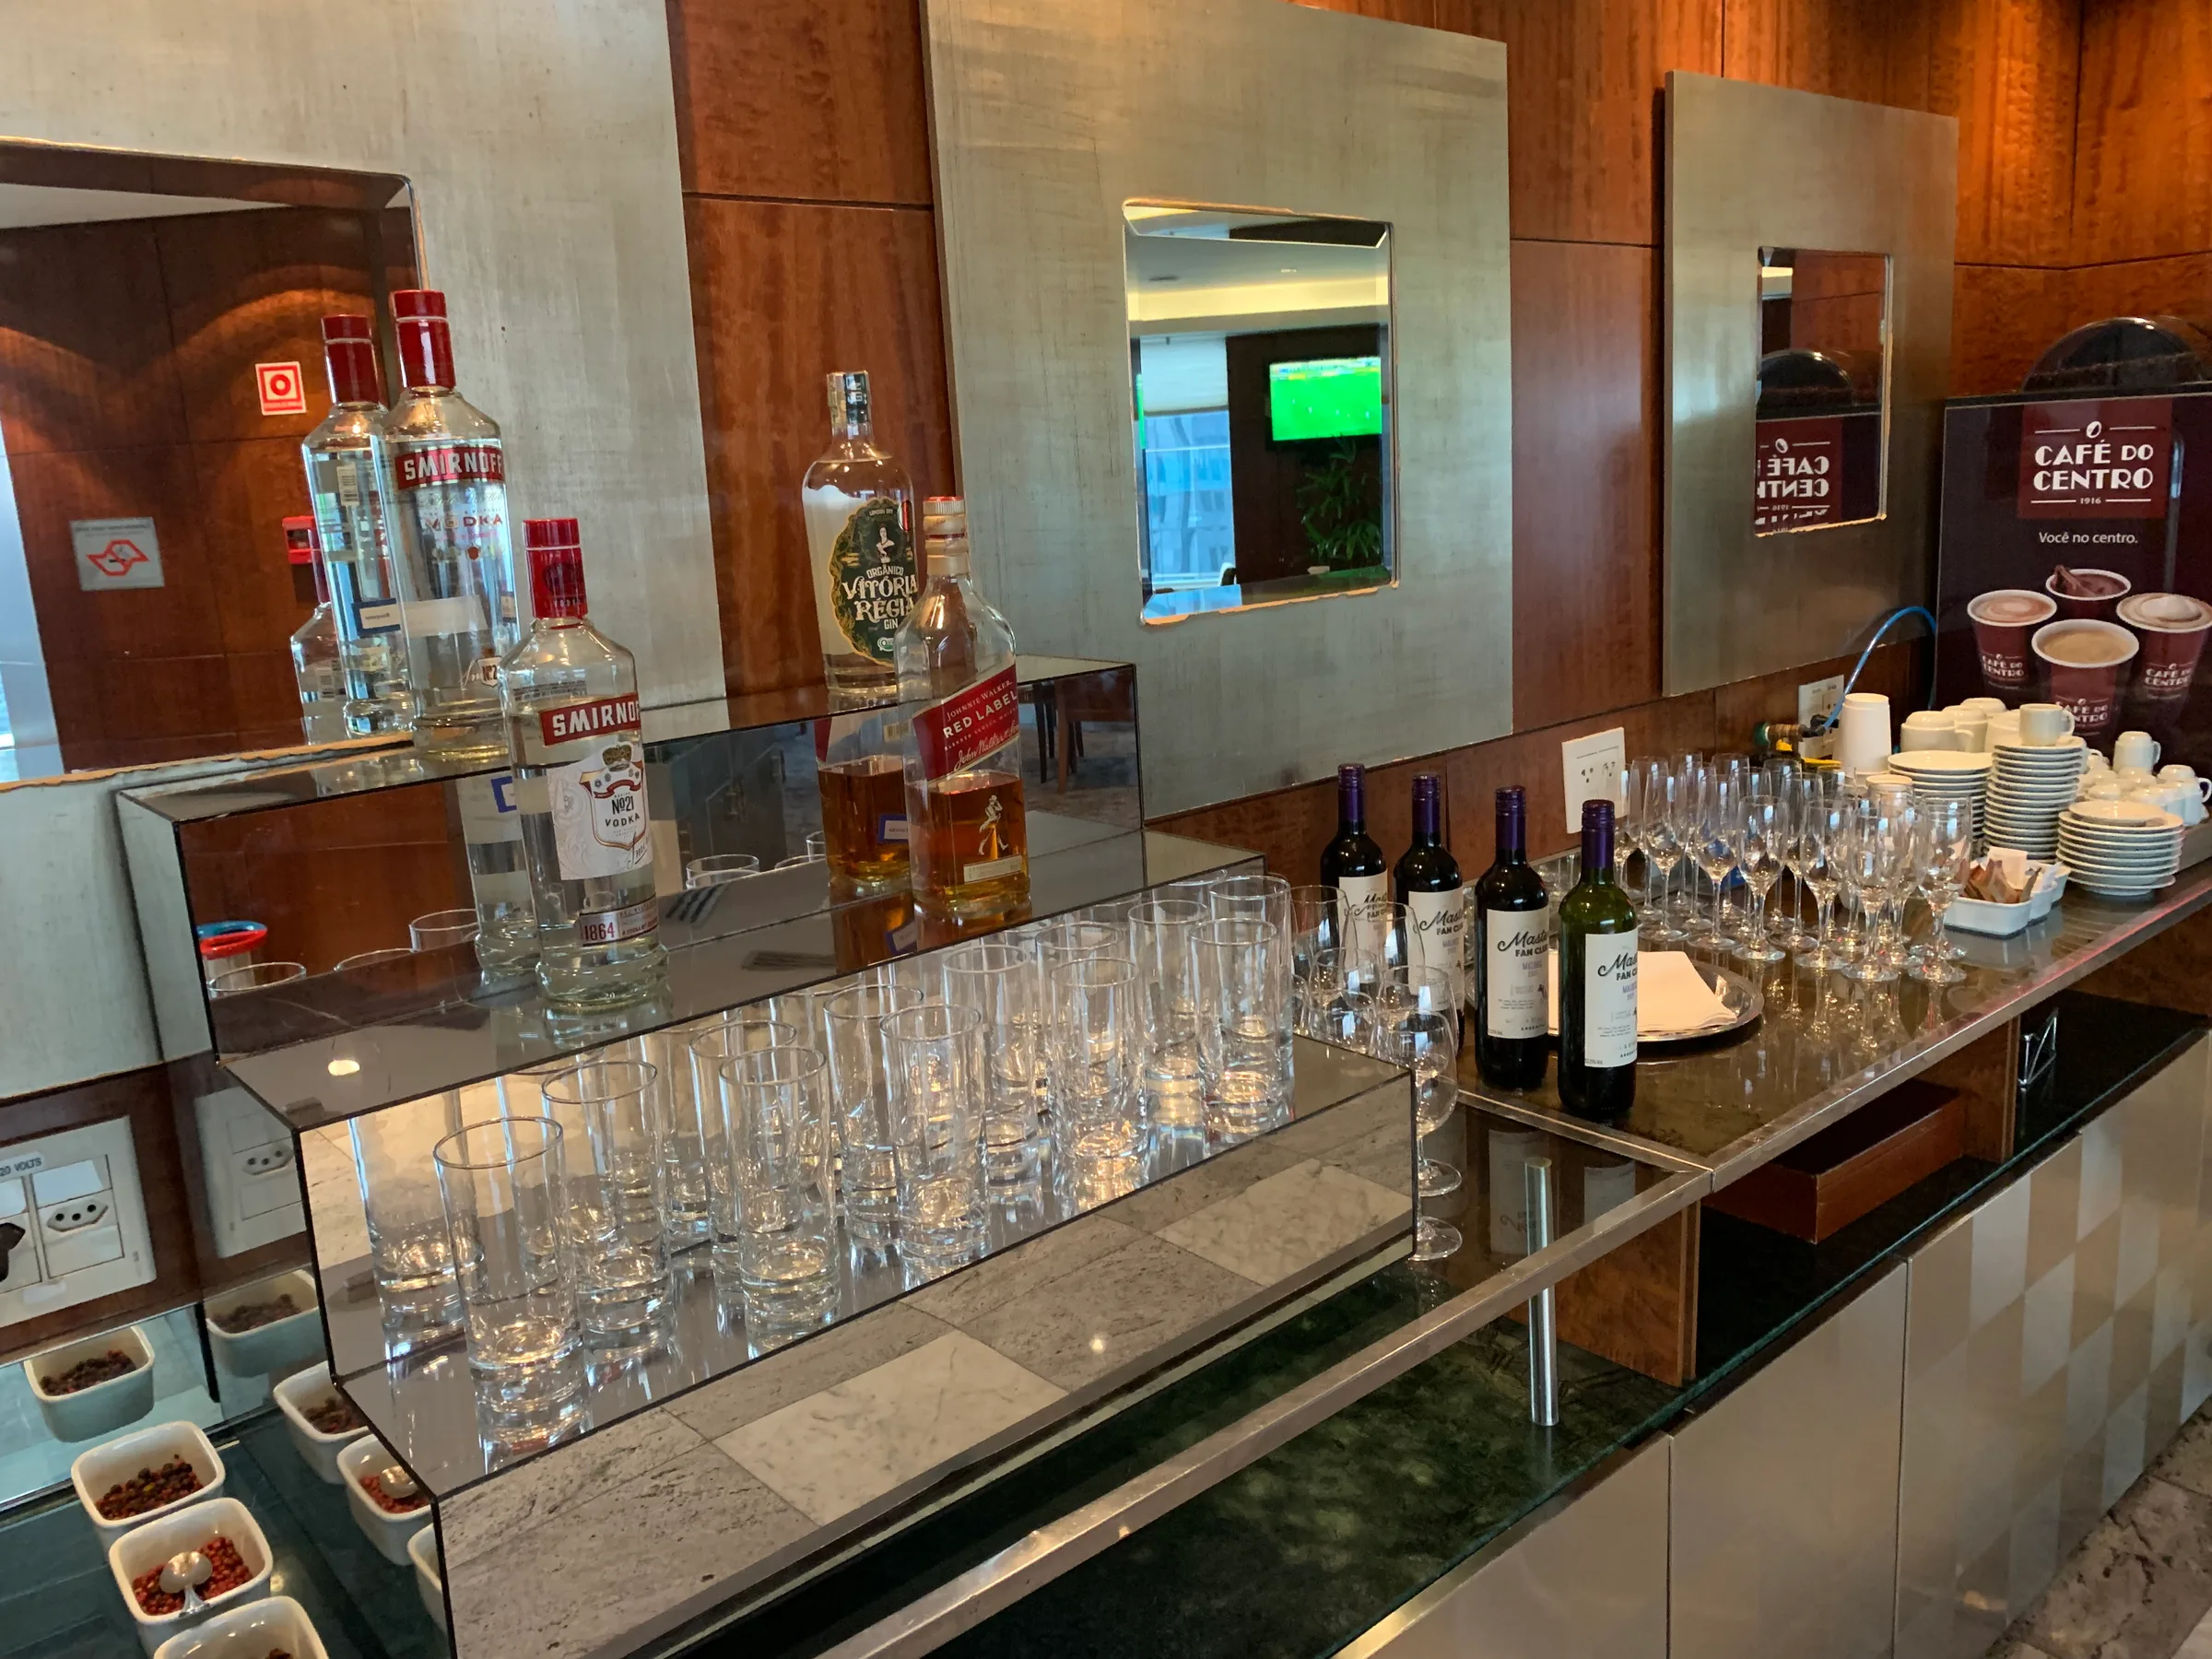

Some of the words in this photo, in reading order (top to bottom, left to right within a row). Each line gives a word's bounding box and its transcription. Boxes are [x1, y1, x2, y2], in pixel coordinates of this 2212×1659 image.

[2034, 440, 2111, 466] CAFÉ
[2121, 443, 2154, 461] DO
[404, 451, 503, 480] SMIRNOFF
[2033, 467, 2154, 491] CENTRO
[2039, 532, 2069, 544] Você
[2072, 535, 2089, 543] no
[2092, 532, 2138, 544] centro.
[866, 563, 904, 579] ORGÂNICO
[842, 574, 918, 599] VITÓRIA
[884, 618, 899, 630] GIN
[943, 716, 973, 738] RED
[975, 690, 1018, 721] LABEL
[947, 697, 980, 722] JOHNNIE
[605, 812, 641, 828] VODKA
[583, 922, 615, 941] 1864
[1515, 947, 1534, 958] FAN
[1616, 972, 1631, 981] FAN
[14, 1157, 42, 1171] VOLTS
